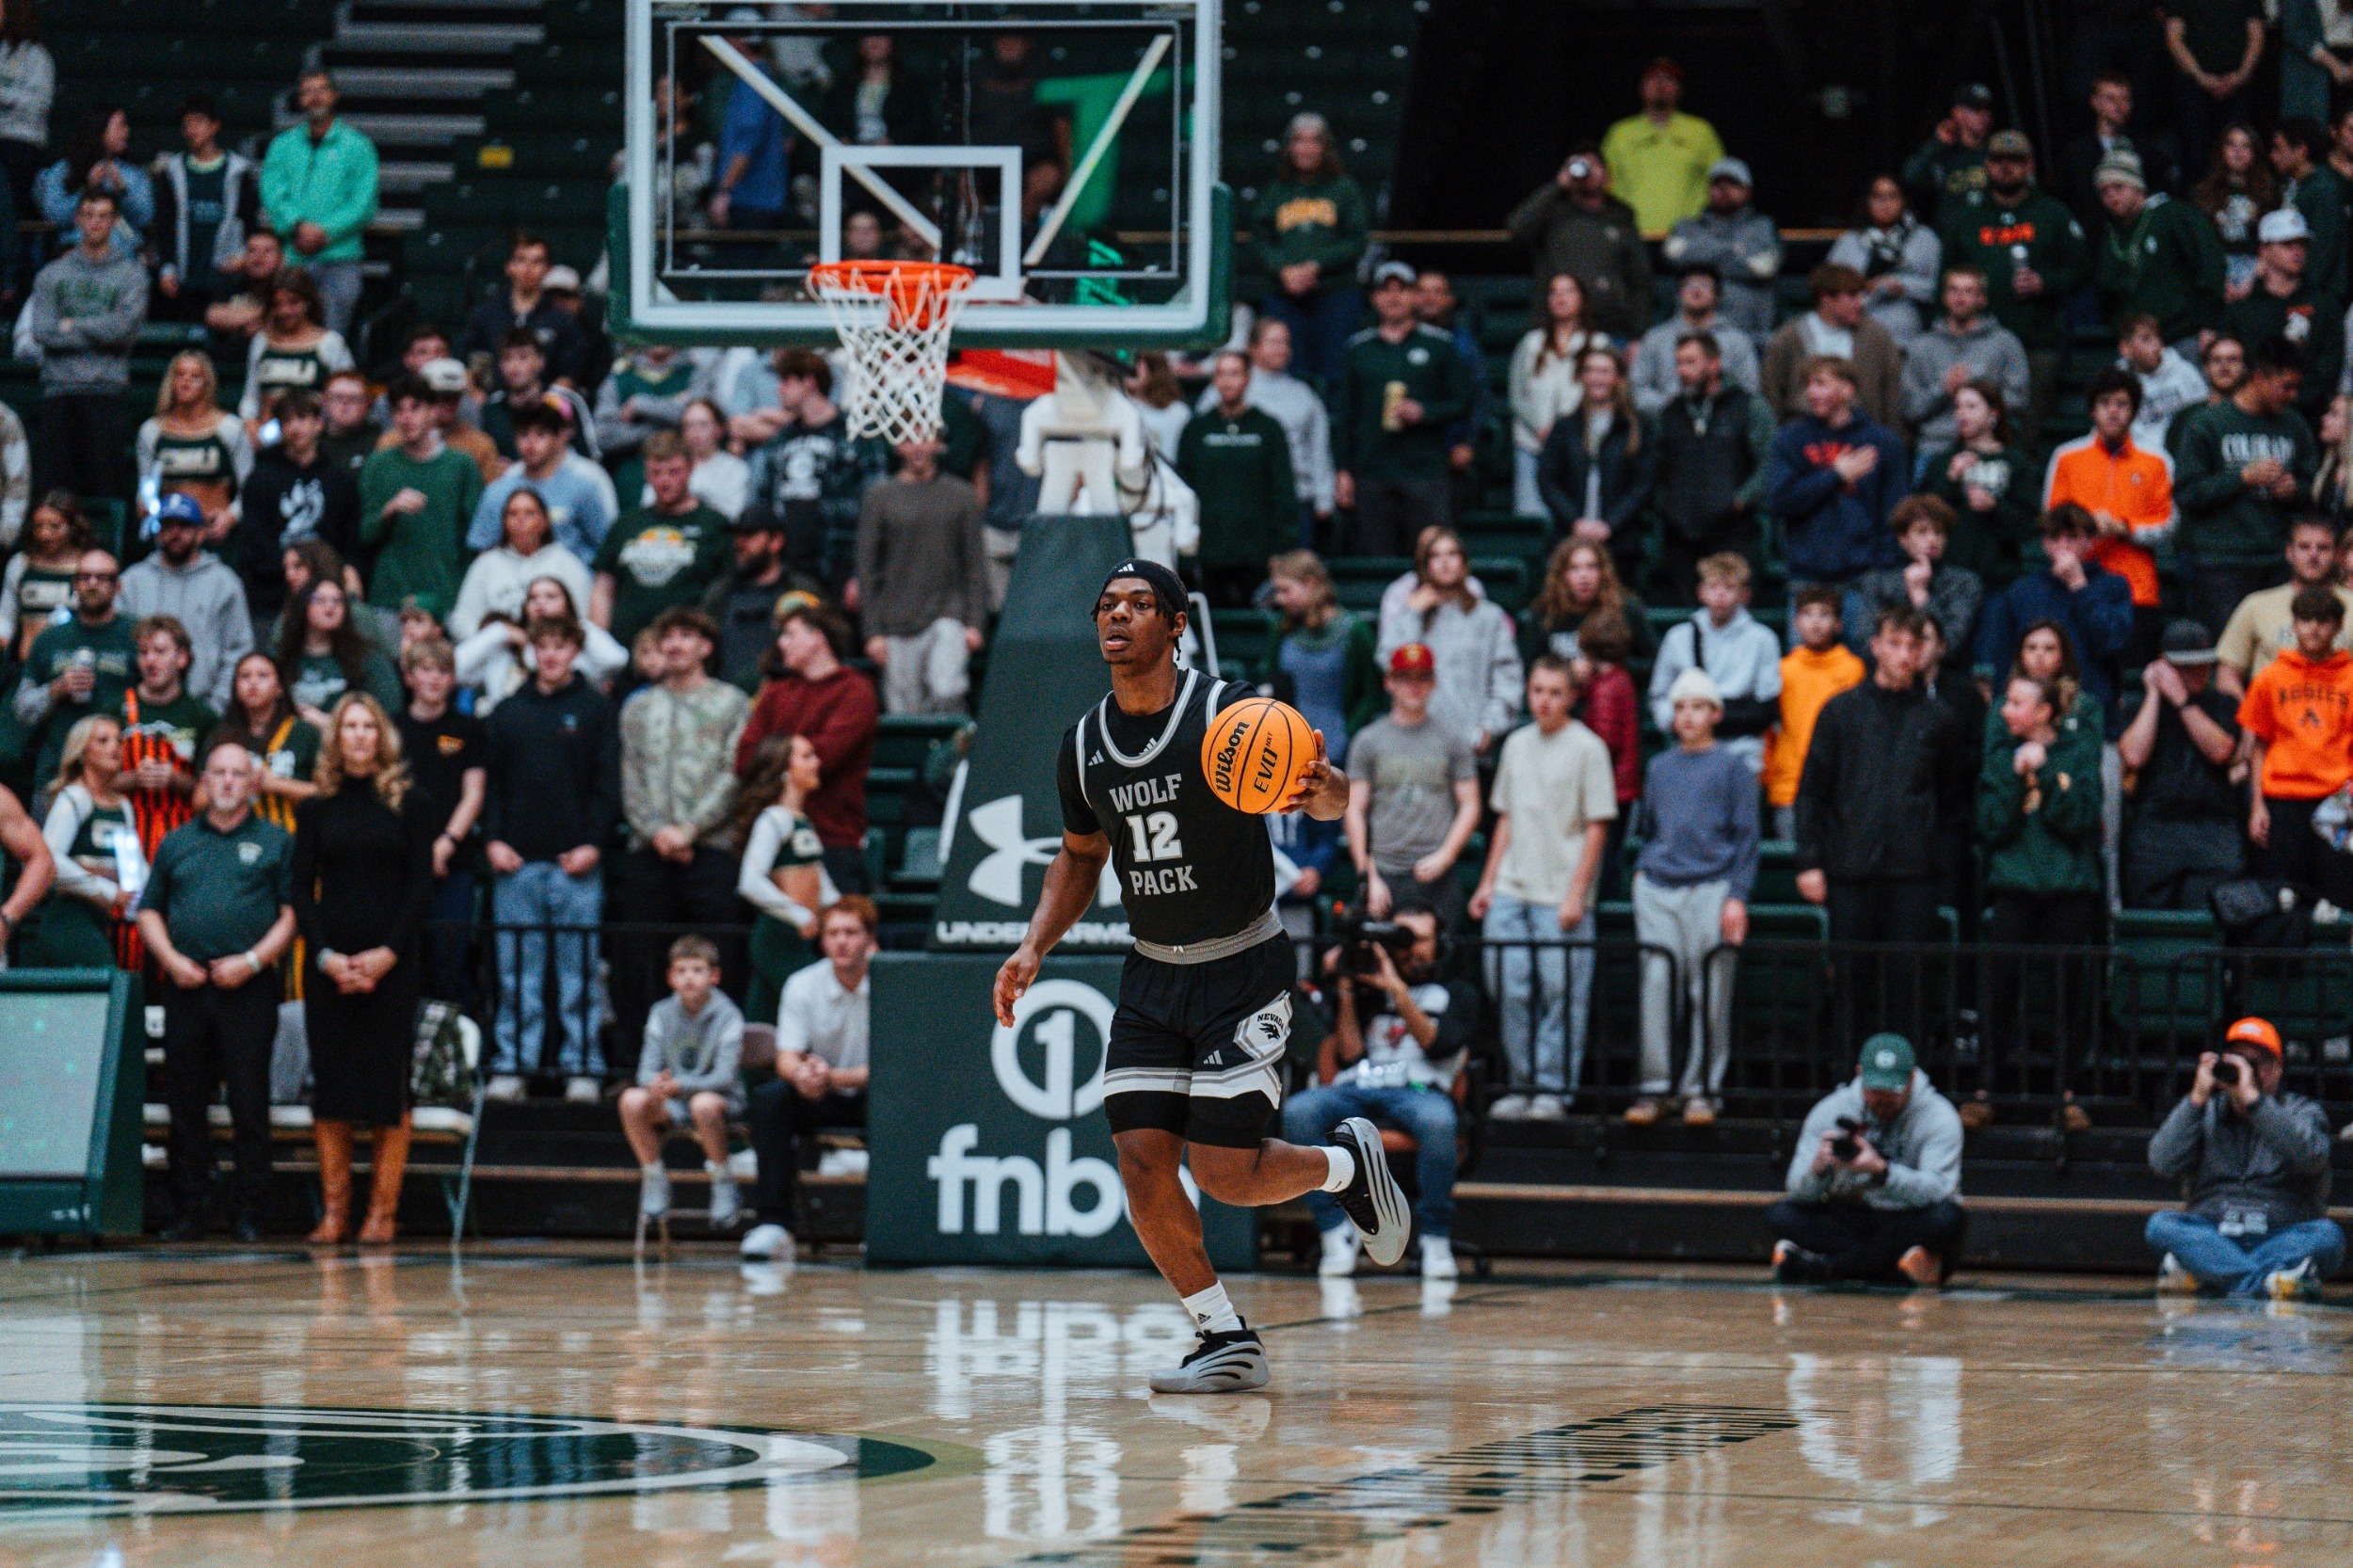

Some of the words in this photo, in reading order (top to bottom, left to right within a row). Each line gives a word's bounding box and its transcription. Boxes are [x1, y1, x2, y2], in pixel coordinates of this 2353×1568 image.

[1215, 721, 1251, 793] Wilson
[1109, 773, 1182, 813] WOLF
[1126, 811, 1182, 863] 12
[1128, 865, 1198, 896] PACK
